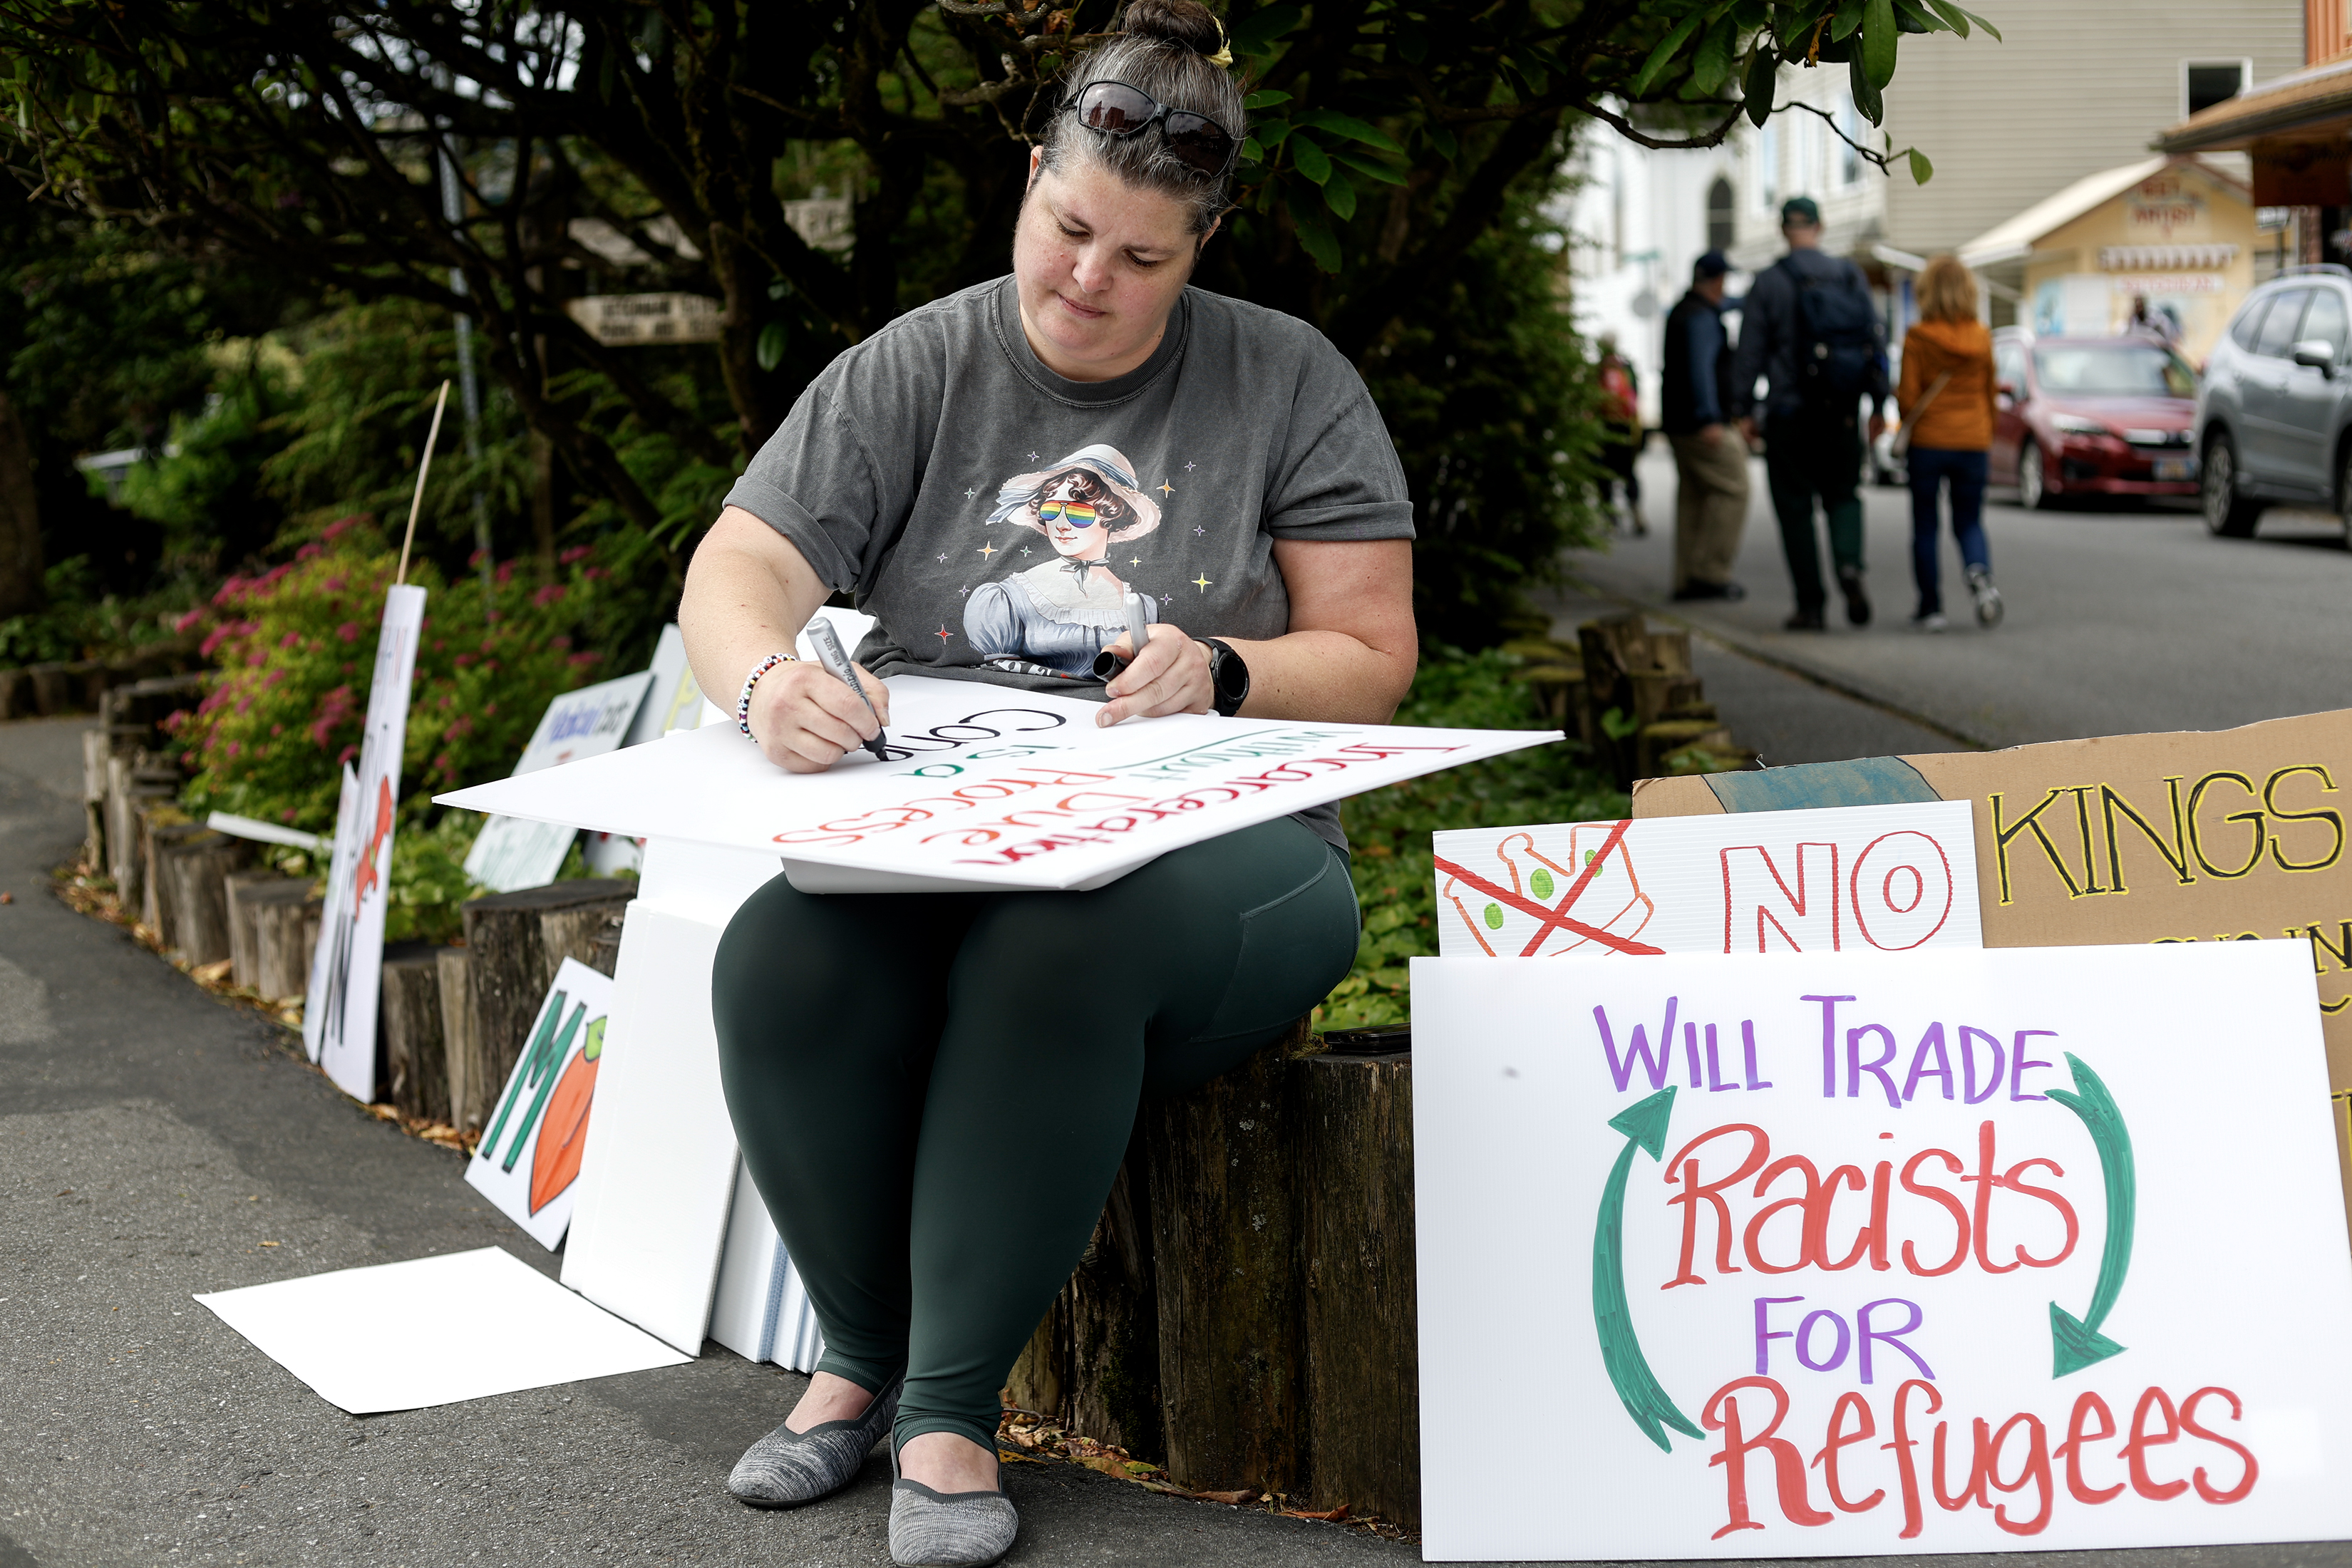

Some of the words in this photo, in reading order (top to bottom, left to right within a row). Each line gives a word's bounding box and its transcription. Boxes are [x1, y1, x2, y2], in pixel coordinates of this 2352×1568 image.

[830, 650, 843, 668] KING
[772, 768, 1115, 847] Process
[890, 763, 965, 778] a
[951, 742, 1471, 866] Incarceration
[1128, 731, 1363, 783] without
[919, 791, 1154, 845] Due
[1987, 764, 2347, 907] KINGS
[1721, 830, 1954, 954] NO
[1593, 996, 1774, 1093] WILL
[1800, 994, 2060, 1109] TRADE
[1661, 1120, 2080, 1291] Racists
[1755, 1295, 1937, 1386] FOR
[1701, 1376, 2260, 1541] Refugees
